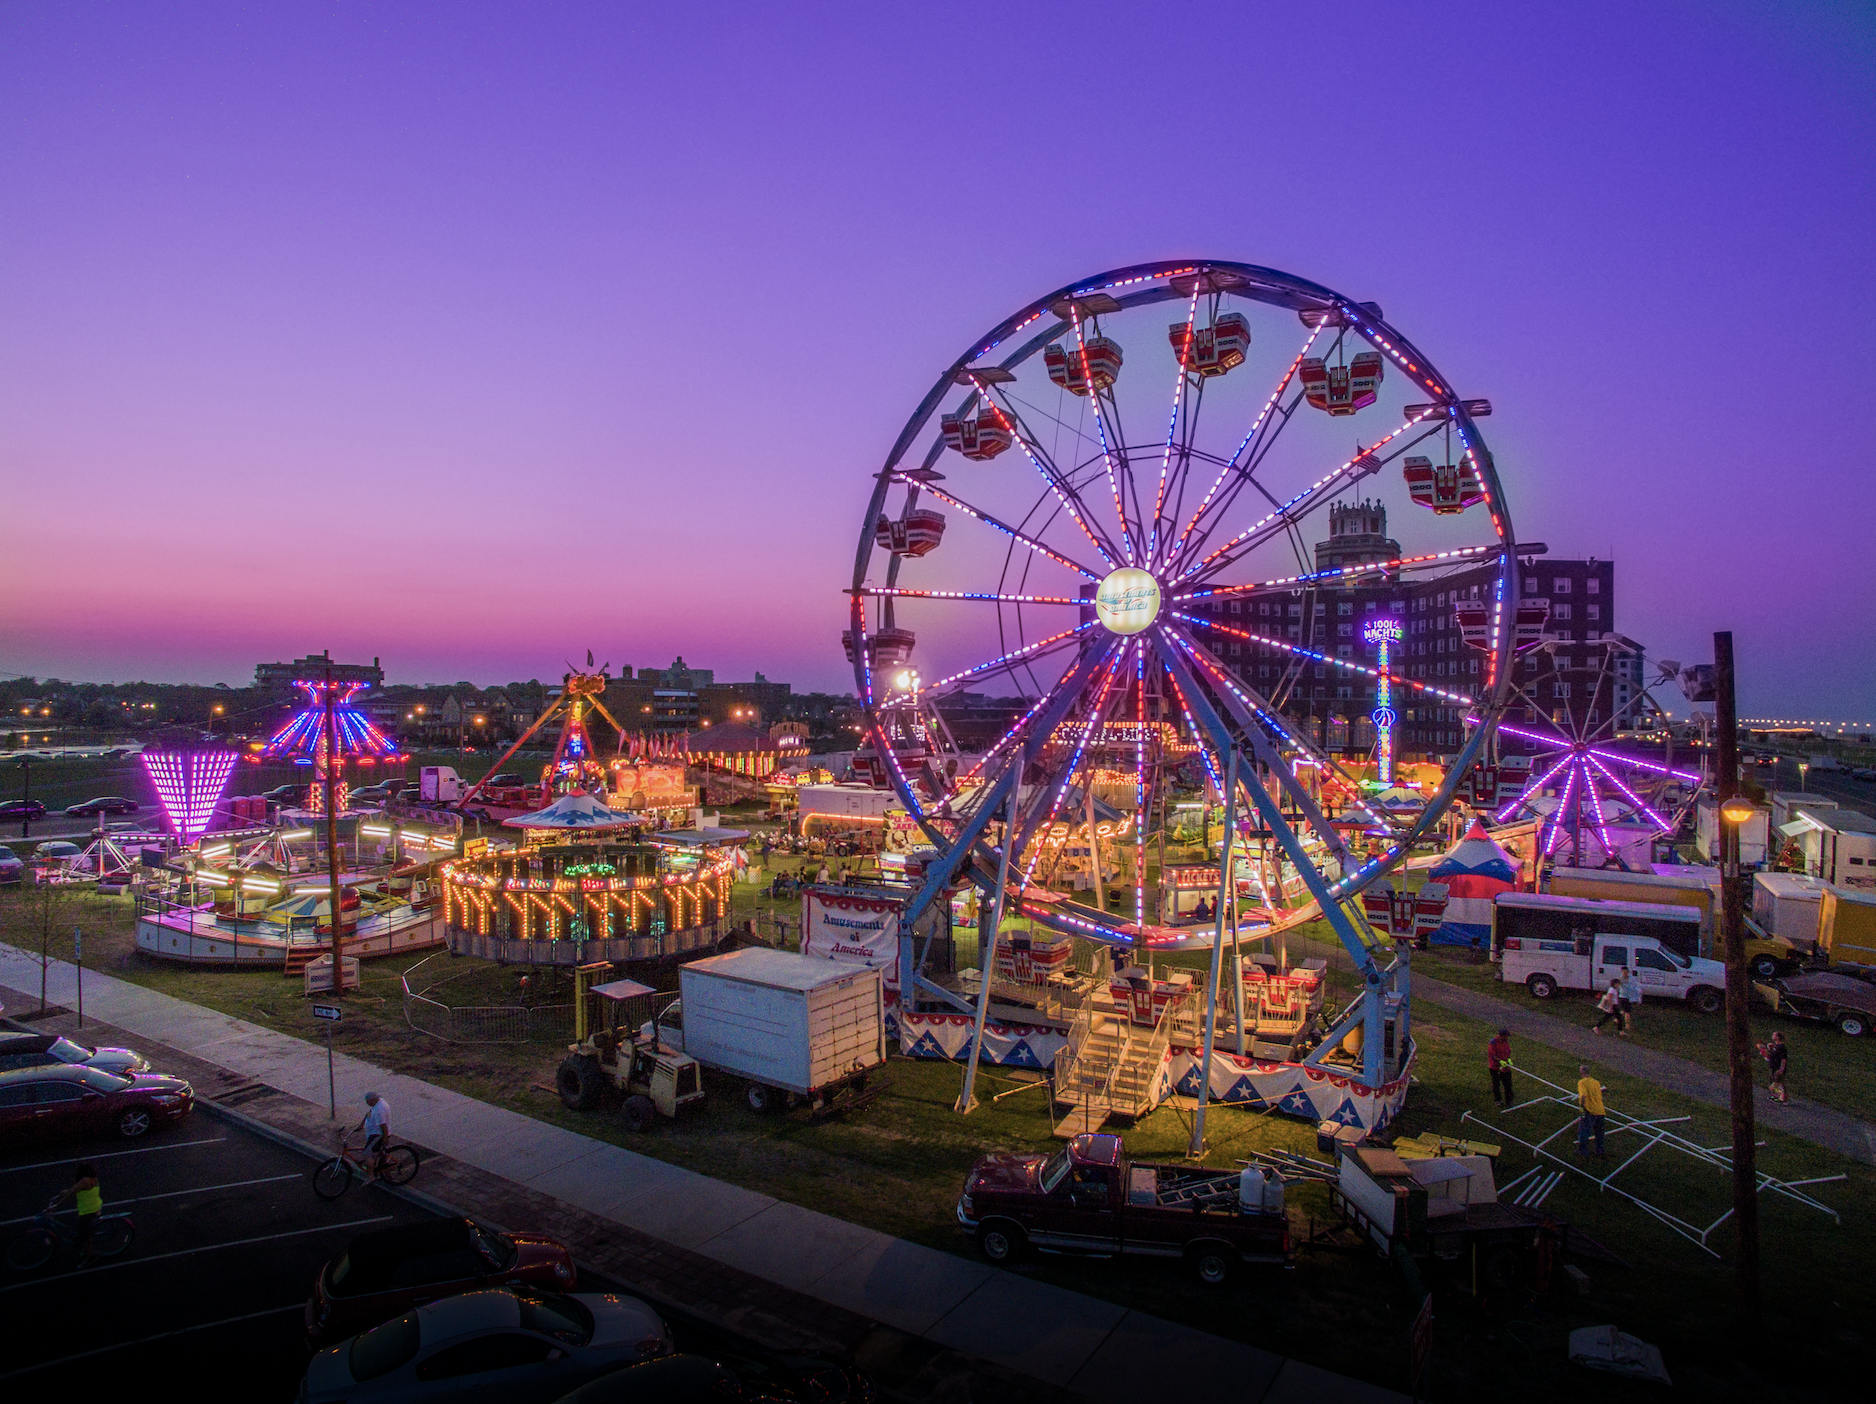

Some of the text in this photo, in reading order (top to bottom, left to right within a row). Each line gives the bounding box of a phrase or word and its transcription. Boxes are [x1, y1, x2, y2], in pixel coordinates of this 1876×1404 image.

[1373, 619, 1393, 629] 1001
[1363, 629, 1402, 639] NACHTS
[1182, 872, 1219, 882] TICKETS
[823, 914, 884, 930] Amusements
[850, 932, 860, 942] of
[831, 942, 873, 957] America
